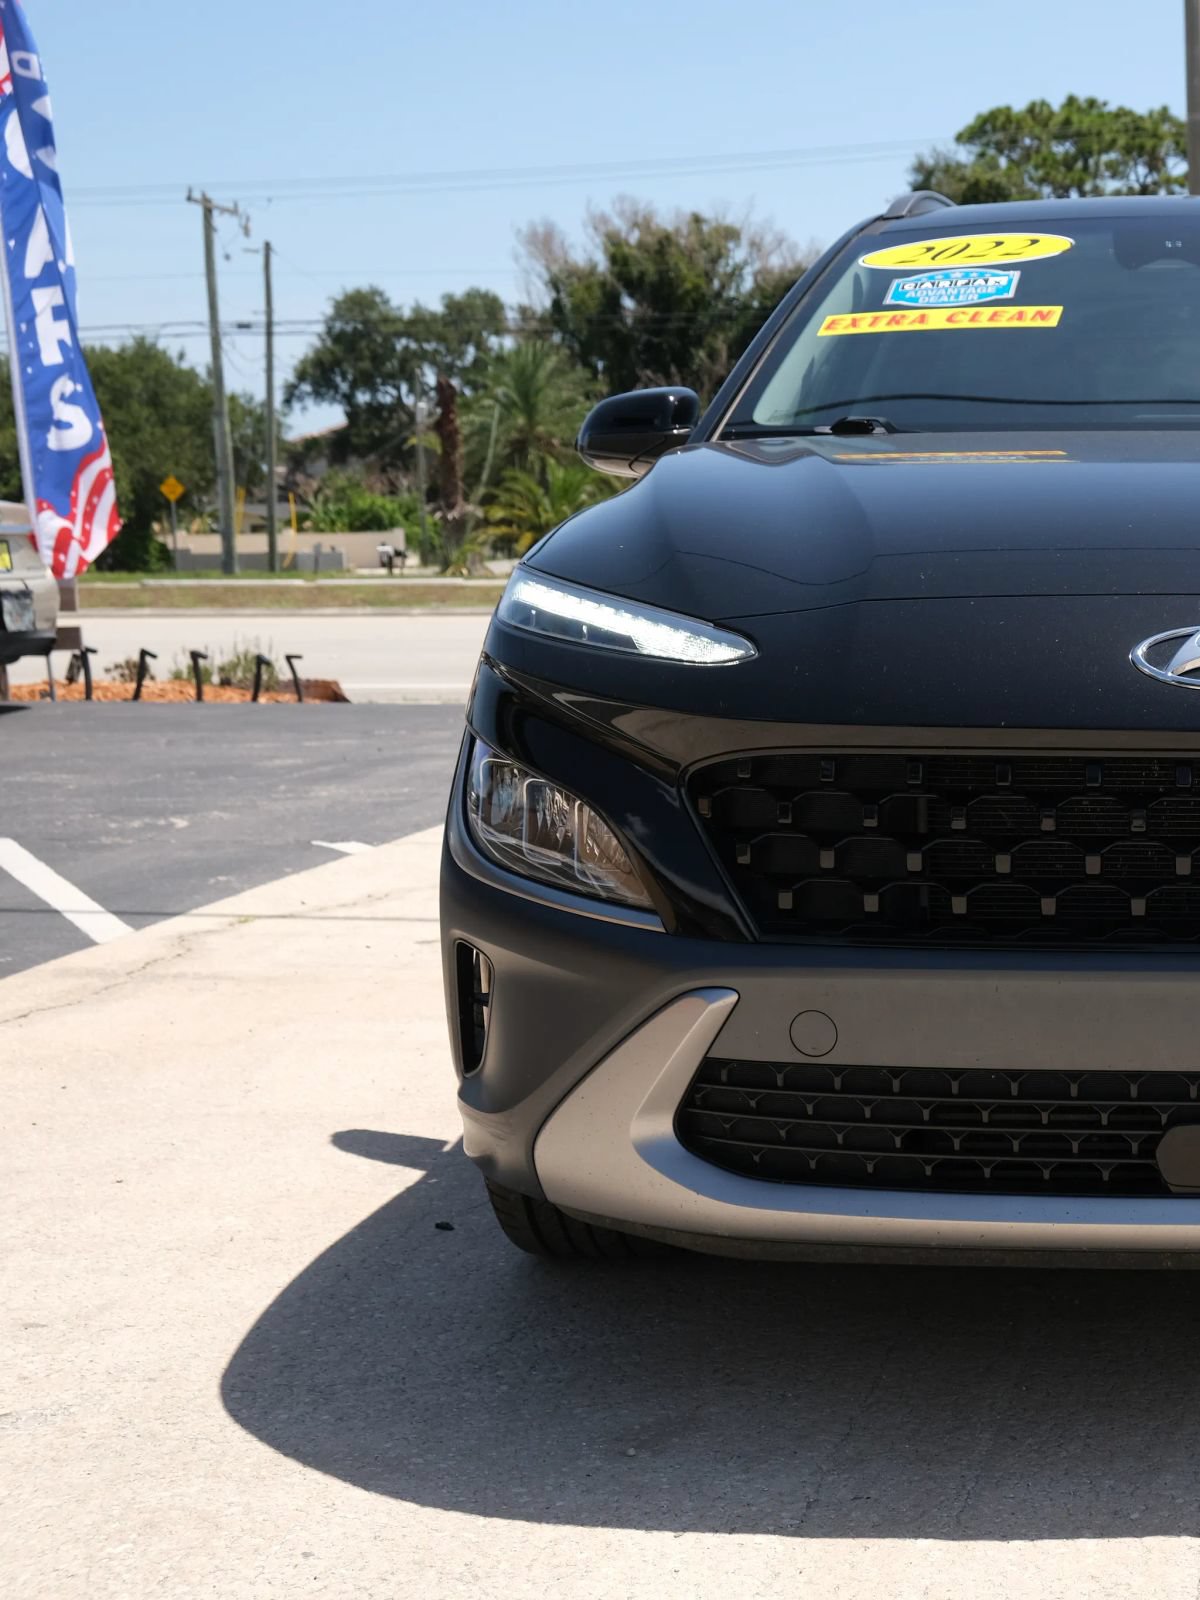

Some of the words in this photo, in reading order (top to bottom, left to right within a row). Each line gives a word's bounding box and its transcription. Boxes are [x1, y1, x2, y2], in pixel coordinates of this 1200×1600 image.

[893, 239, 1041, 265] 2022
[905, 285, 997, 298] ADVANTAGE
[918, 293, 979, 304] DEALER
[824, 312, 928, 332] EXTRA
[945, 310, 1053, 327] CLEAN
